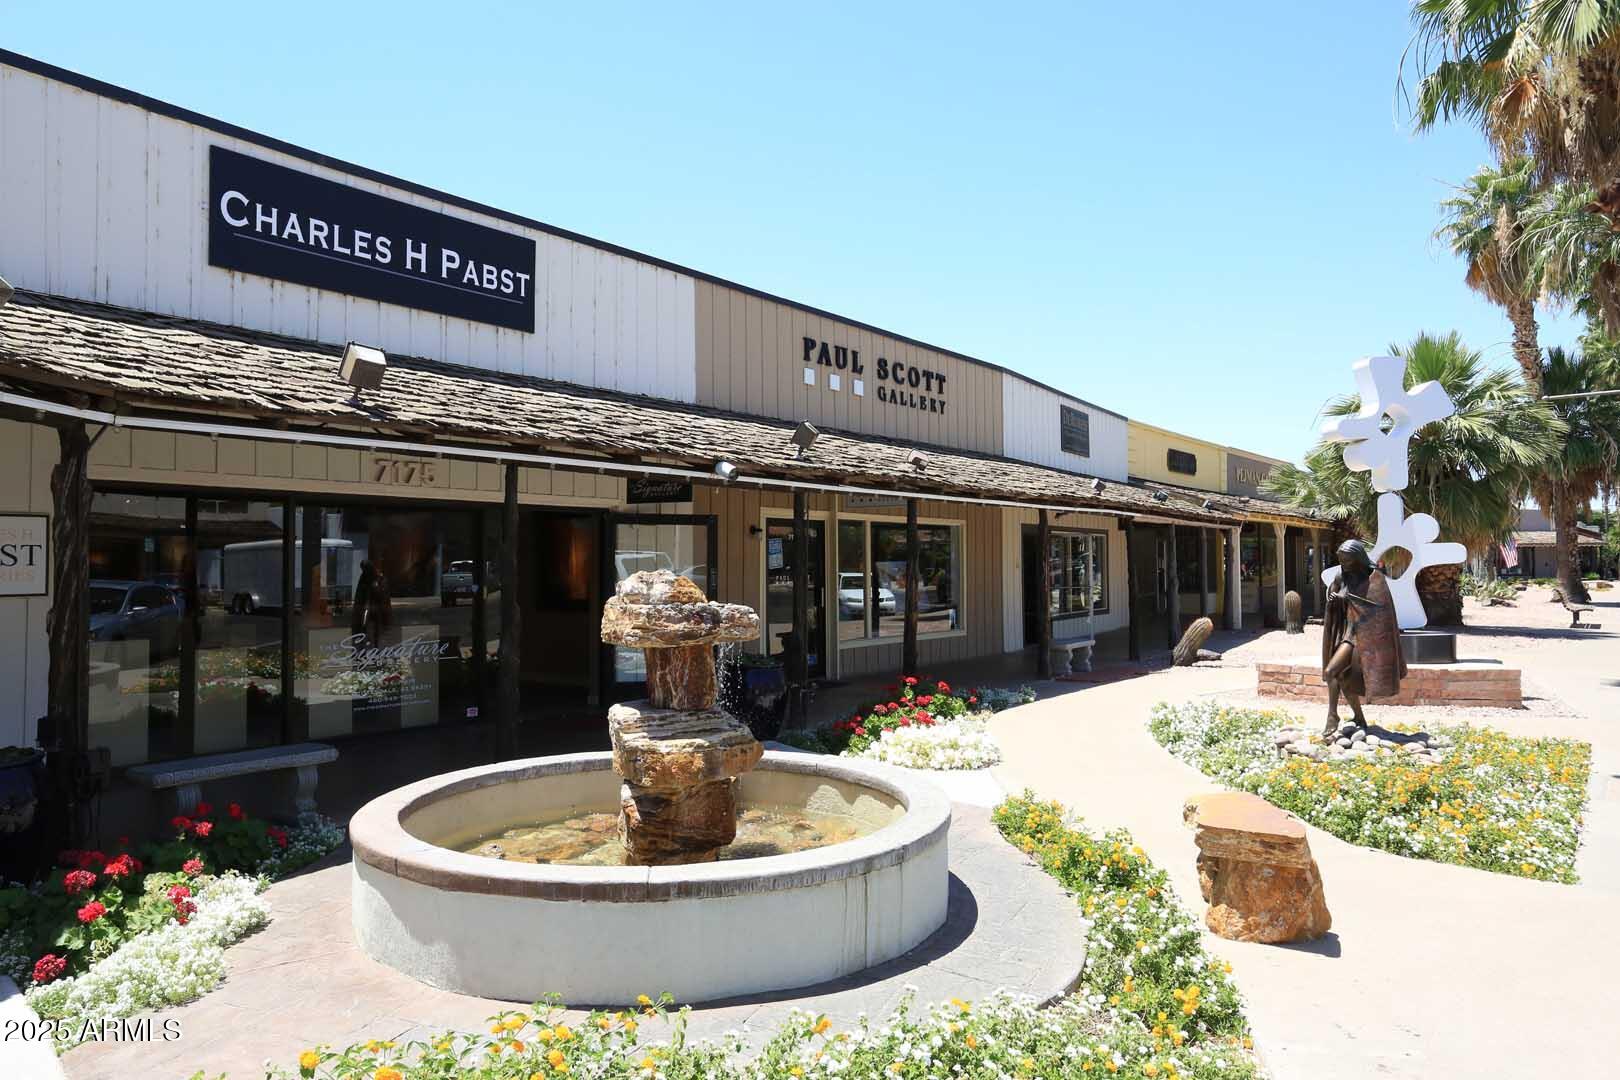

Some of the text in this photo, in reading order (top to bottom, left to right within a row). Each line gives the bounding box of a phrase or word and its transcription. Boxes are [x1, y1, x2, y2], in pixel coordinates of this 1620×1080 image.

[220, 190, 530, 297] CHARLES H PABST
[802, 337, 946, 394] PAUL SCOTT
[877, 386, 946, 415] GALLERY
[375, 458, 435, 486] 7175
[331, 632, 449, 671] Signature
